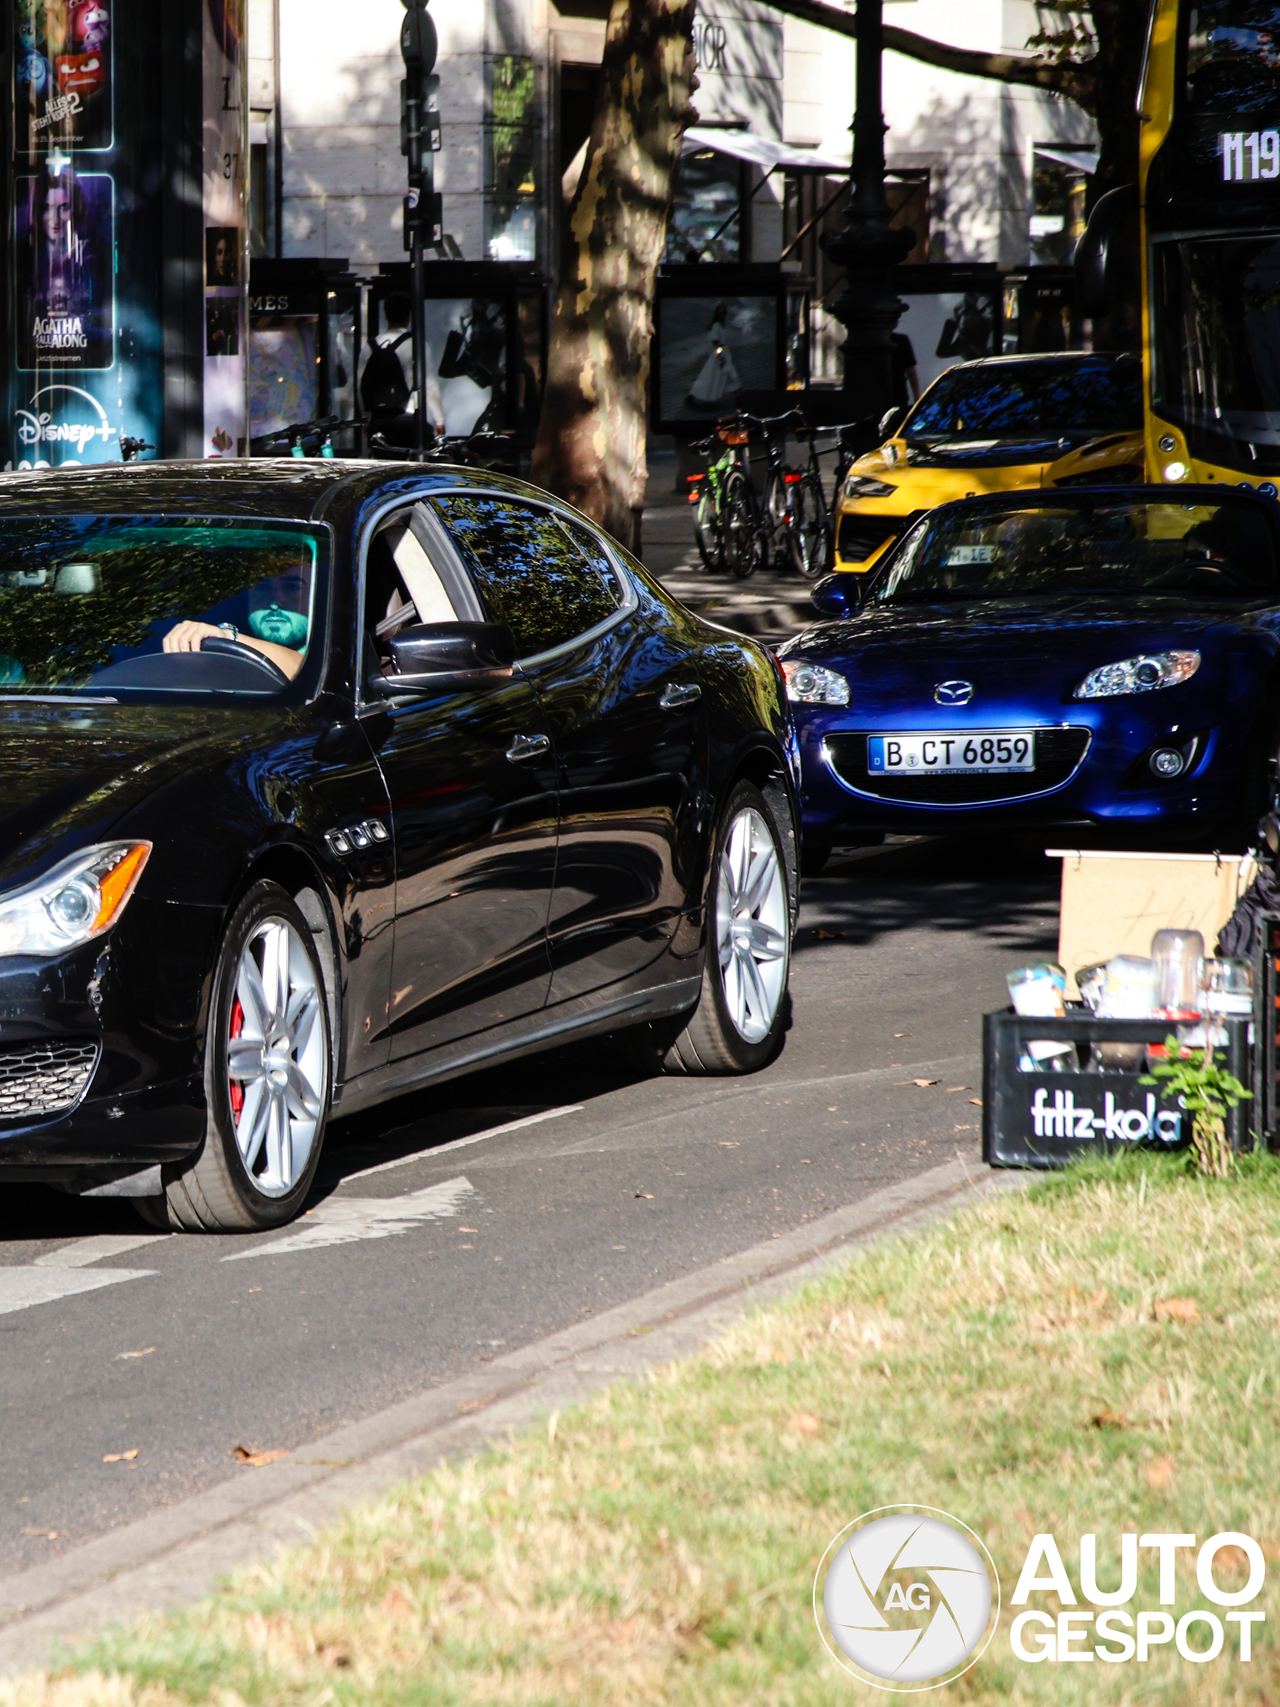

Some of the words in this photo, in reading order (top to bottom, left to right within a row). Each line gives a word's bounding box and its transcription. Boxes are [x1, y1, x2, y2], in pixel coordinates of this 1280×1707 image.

[66, 91, 84, 115] 2
[1222, 131, 1280, 181] M19
[33, 315, 83, 337] AGATHA
[51, 333, 88, 349] ALONG
[874, 757, 881, 766] D
[887, 741, 903, 766] B
[922, 740, 956, 766] CT
[963, 738, 1029, 764] 6859
